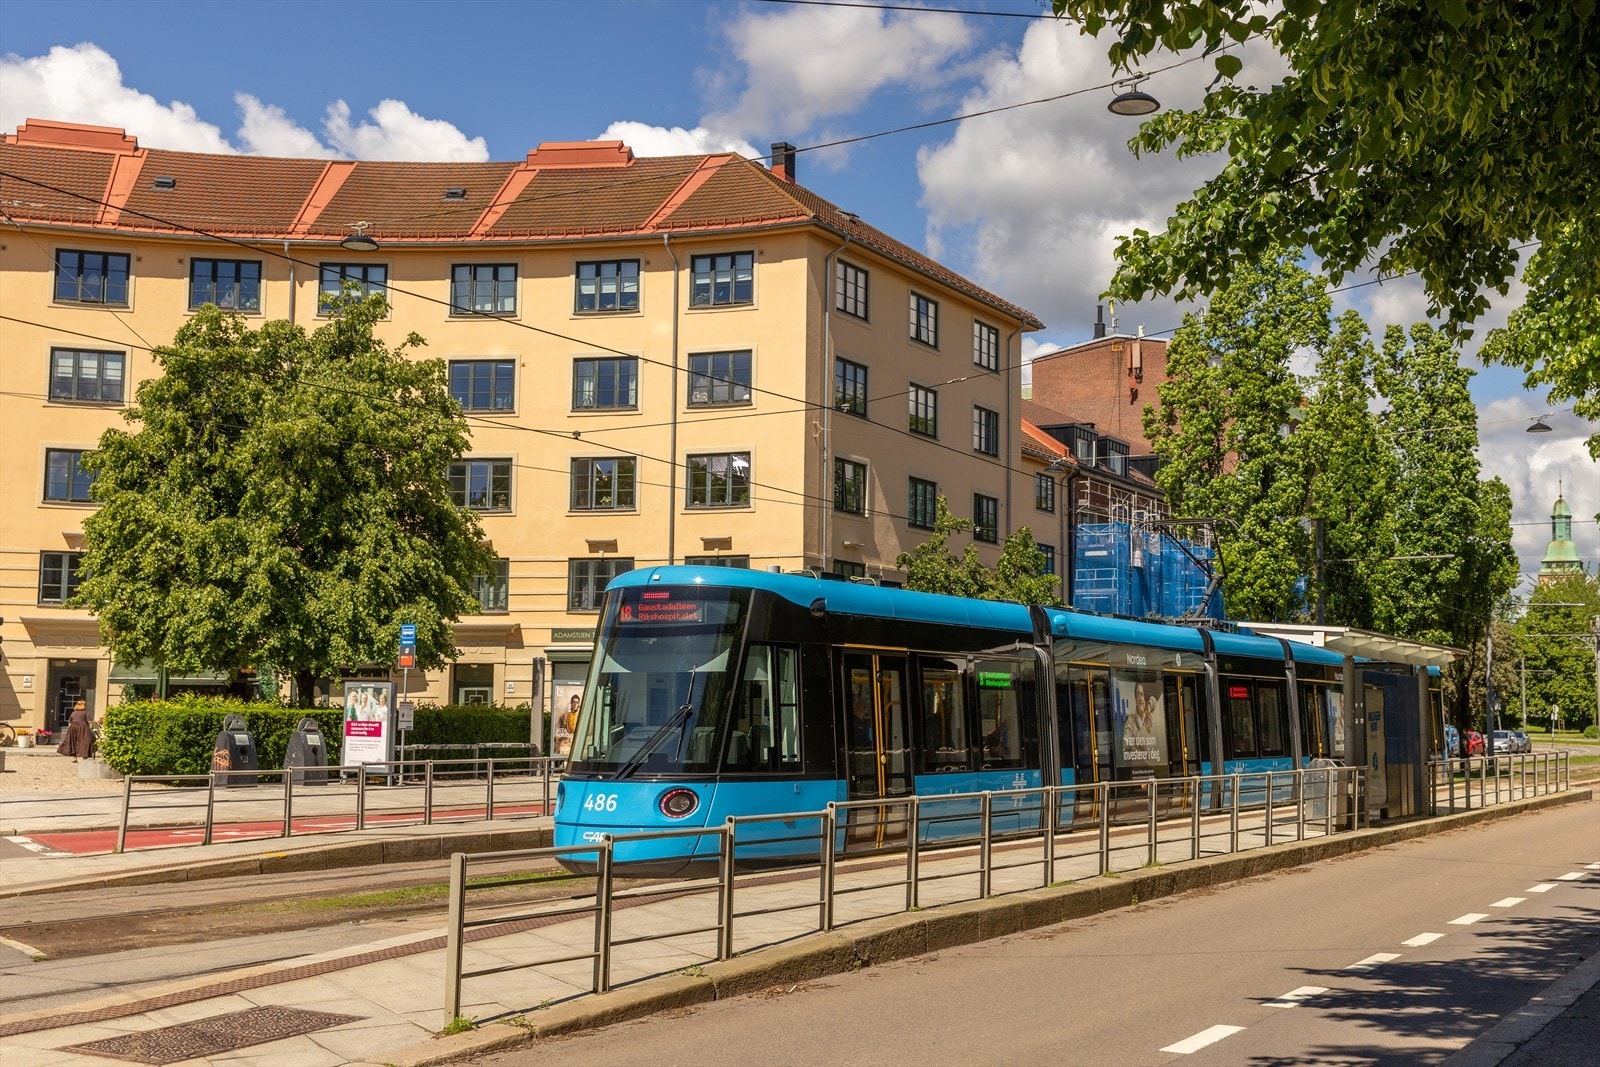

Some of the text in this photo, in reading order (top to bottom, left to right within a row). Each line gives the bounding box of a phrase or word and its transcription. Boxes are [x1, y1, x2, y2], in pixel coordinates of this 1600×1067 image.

[638, 602, 697, 611] Gaustadalléen
[621, 605, 632, 621] 18
[638, 612, 698, 621] Rikshospitalet
[553, 631, 591, 639] ADAMSTUEN
[1126, 653, 1147, 666] Nordea
[1136, 734, 1146, 746] den
[1146, 736, 1157, 746] som
[1123, 748, 1148, 760] investerer
[1150, 748, 1161, 762] deg
[584, 793, 618, 812] 486
